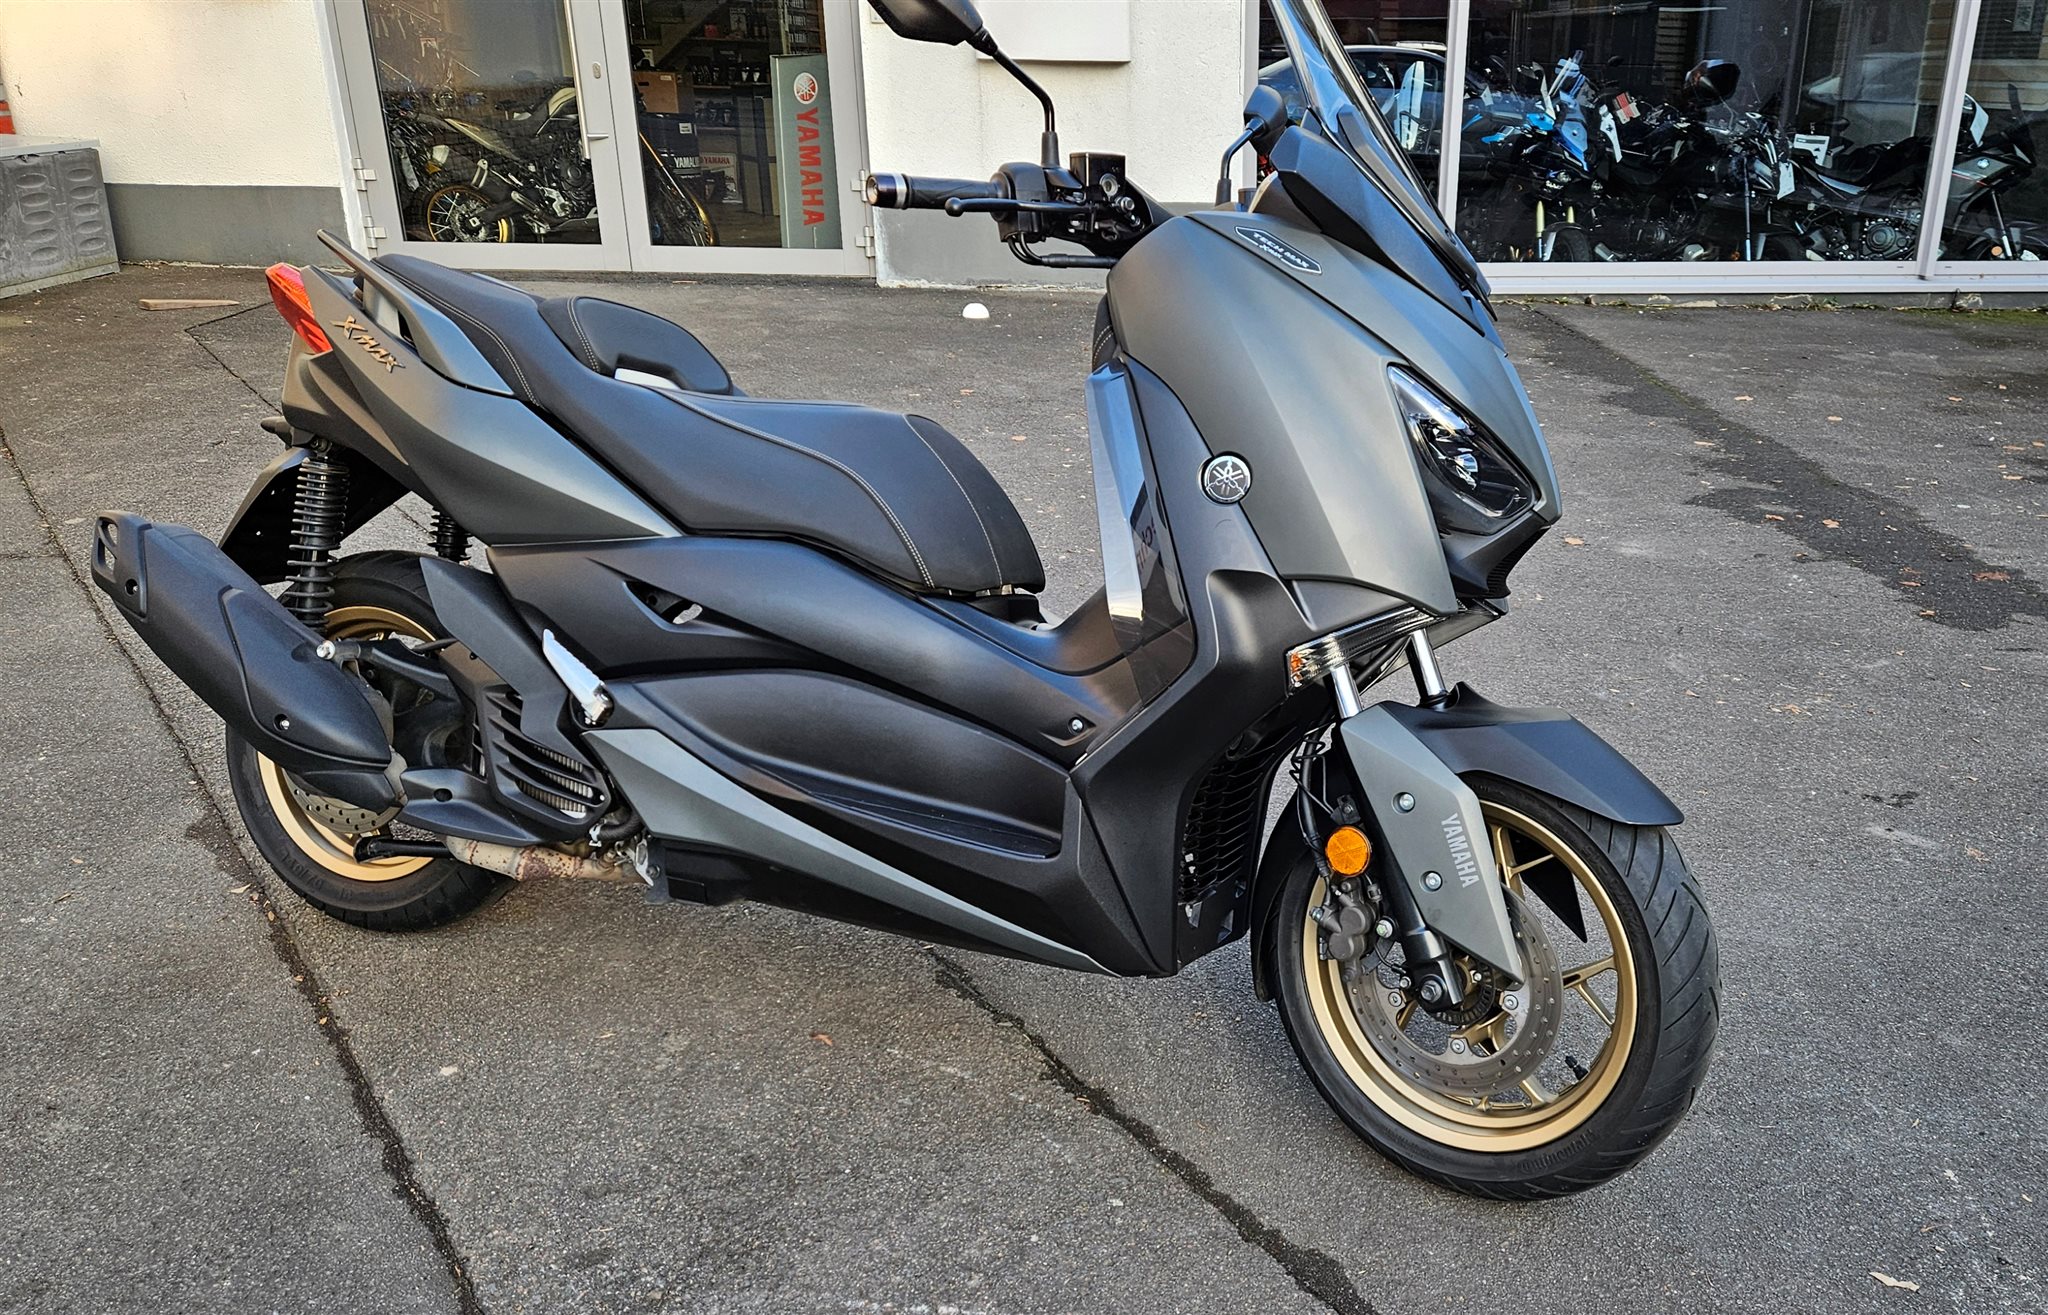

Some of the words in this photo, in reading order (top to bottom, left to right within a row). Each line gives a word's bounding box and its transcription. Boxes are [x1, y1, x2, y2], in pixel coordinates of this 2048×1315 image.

[703, 156, 730, 165] YAMAHA
[796, 107, 825, 226] YAMAHA
[1252, 232, 1285, 253] TECH
[1283, 250, 1310, 268] MAX
[1441, 812, 1479, 888] YAMAHA
